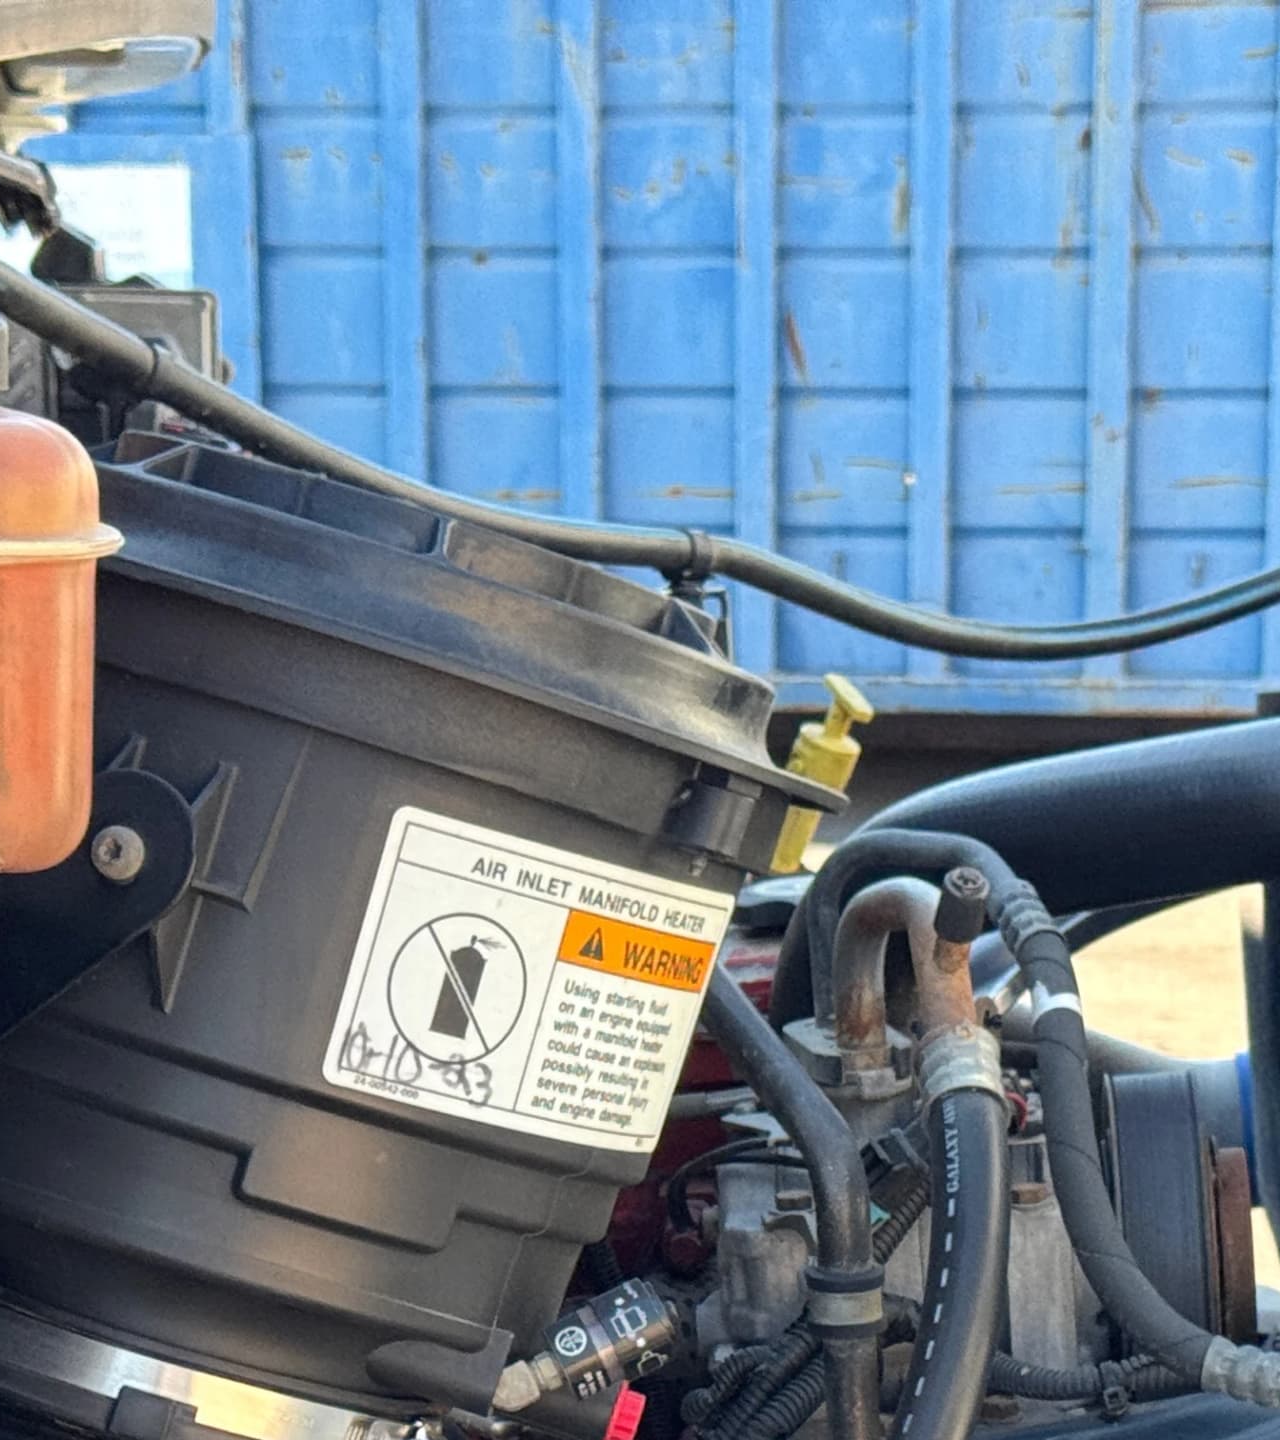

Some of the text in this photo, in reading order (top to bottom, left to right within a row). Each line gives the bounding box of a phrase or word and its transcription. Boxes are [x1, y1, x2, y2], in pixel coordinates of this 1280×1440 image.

[471, 856, 704, 934] AIR INLET MANIFOLD HEATER
[623, 940, 703, 983] WARNING
[564, 979, 600, 1005] Using
[606, 992, 645, 1015] starting
[558, 1002, 575, 1014] on
[580, 1006, 594, 1019] an
[599, 1011, 633, 1029] engine
[554, 1020, 579, 1035] with
[583, 1027, 591, 1039] a
[595, 1030, 638, 1048] manifold
[547, 1039, 582, 1056] could
[585, 1048, 616, 1064] cause
[541, 1058, 593, 1083] possibly
[598, 1071, 638, 1092] resulting
[537, 1077, 577, 1095] severe
[582, 1088, 626, 1105] personal
[531, 1095, 556, 1111] and
[559, 1102, 595, 1120] engine
[944, 1129, 959, 1193] GALAXY
